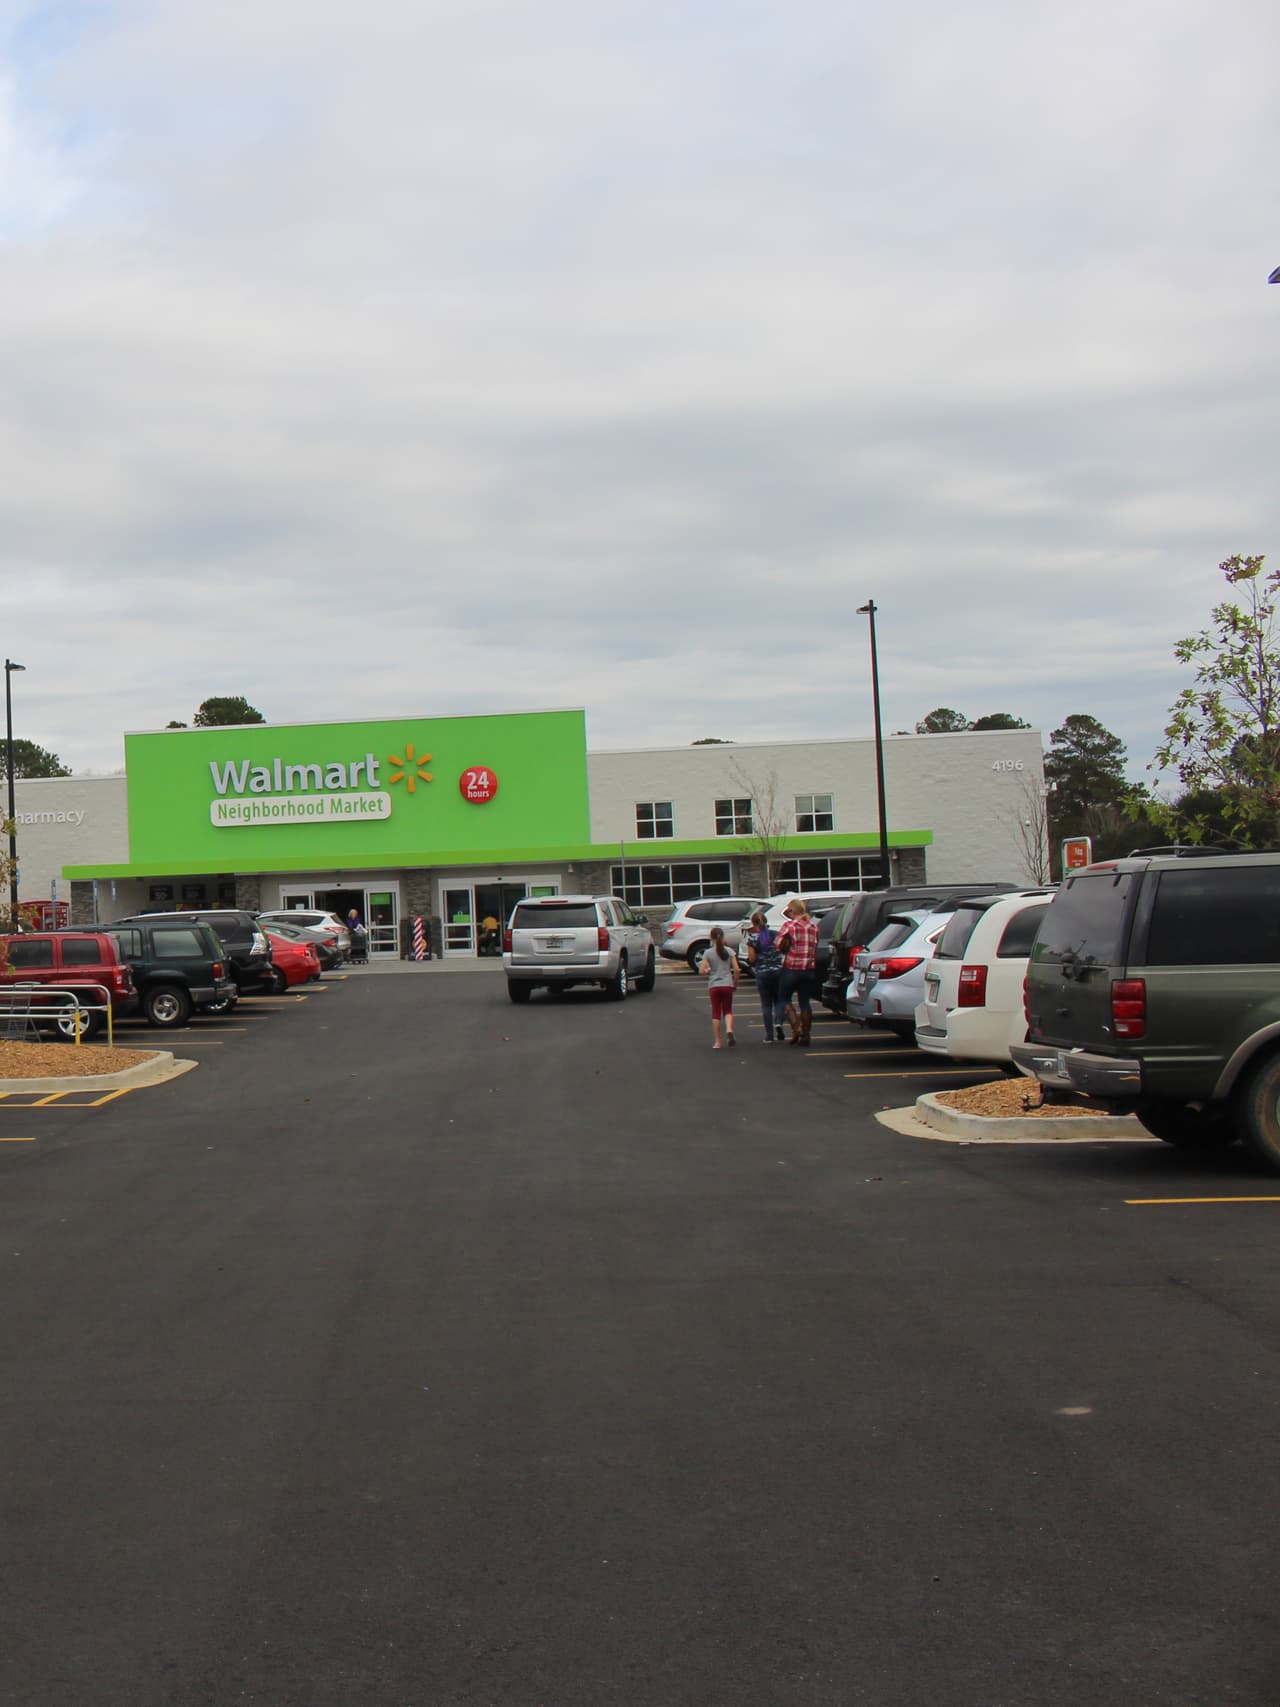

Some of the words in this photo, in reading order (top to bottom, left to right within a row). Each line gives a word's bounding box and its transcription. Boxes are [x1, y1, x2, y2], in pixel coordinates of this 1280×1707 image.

[209, 753, 381, 795] Walmart
[992, 760, 1024, 772] 4196
[467, 771, 489, 790] 24
[467, 789, 490, 798] hours
[7, 808, 85, 826] harmacy
[218, 799, 324, 822] Neighborhood
[330, 797, 384, 814] Market
